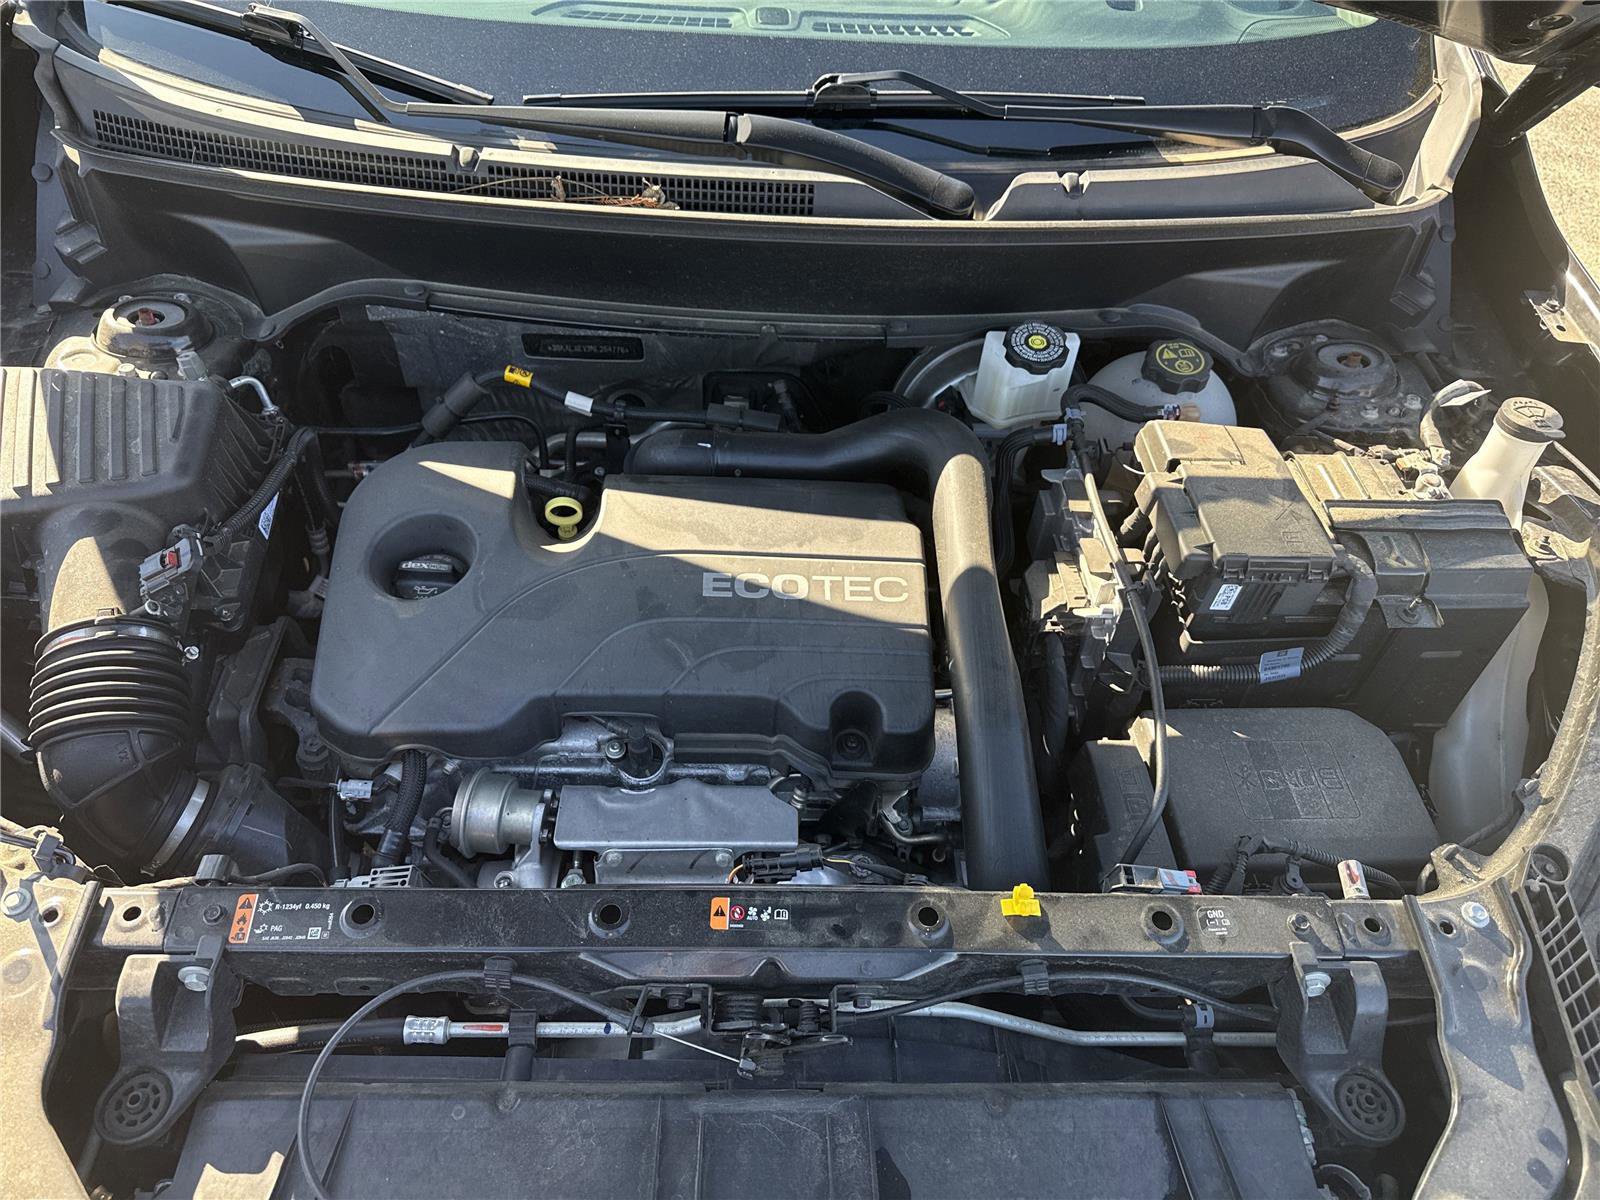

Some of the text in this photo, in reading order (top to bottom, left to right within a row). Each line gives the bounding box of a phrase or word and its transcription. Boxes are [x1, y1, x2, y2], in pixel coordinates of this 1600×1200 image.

[702, 571, 910, 603] ECOTEC
[274, 902, 302, 911] R-1234yf
[322, 902, 330, 910] kg
[1207, 910, 1224, 918] GND
